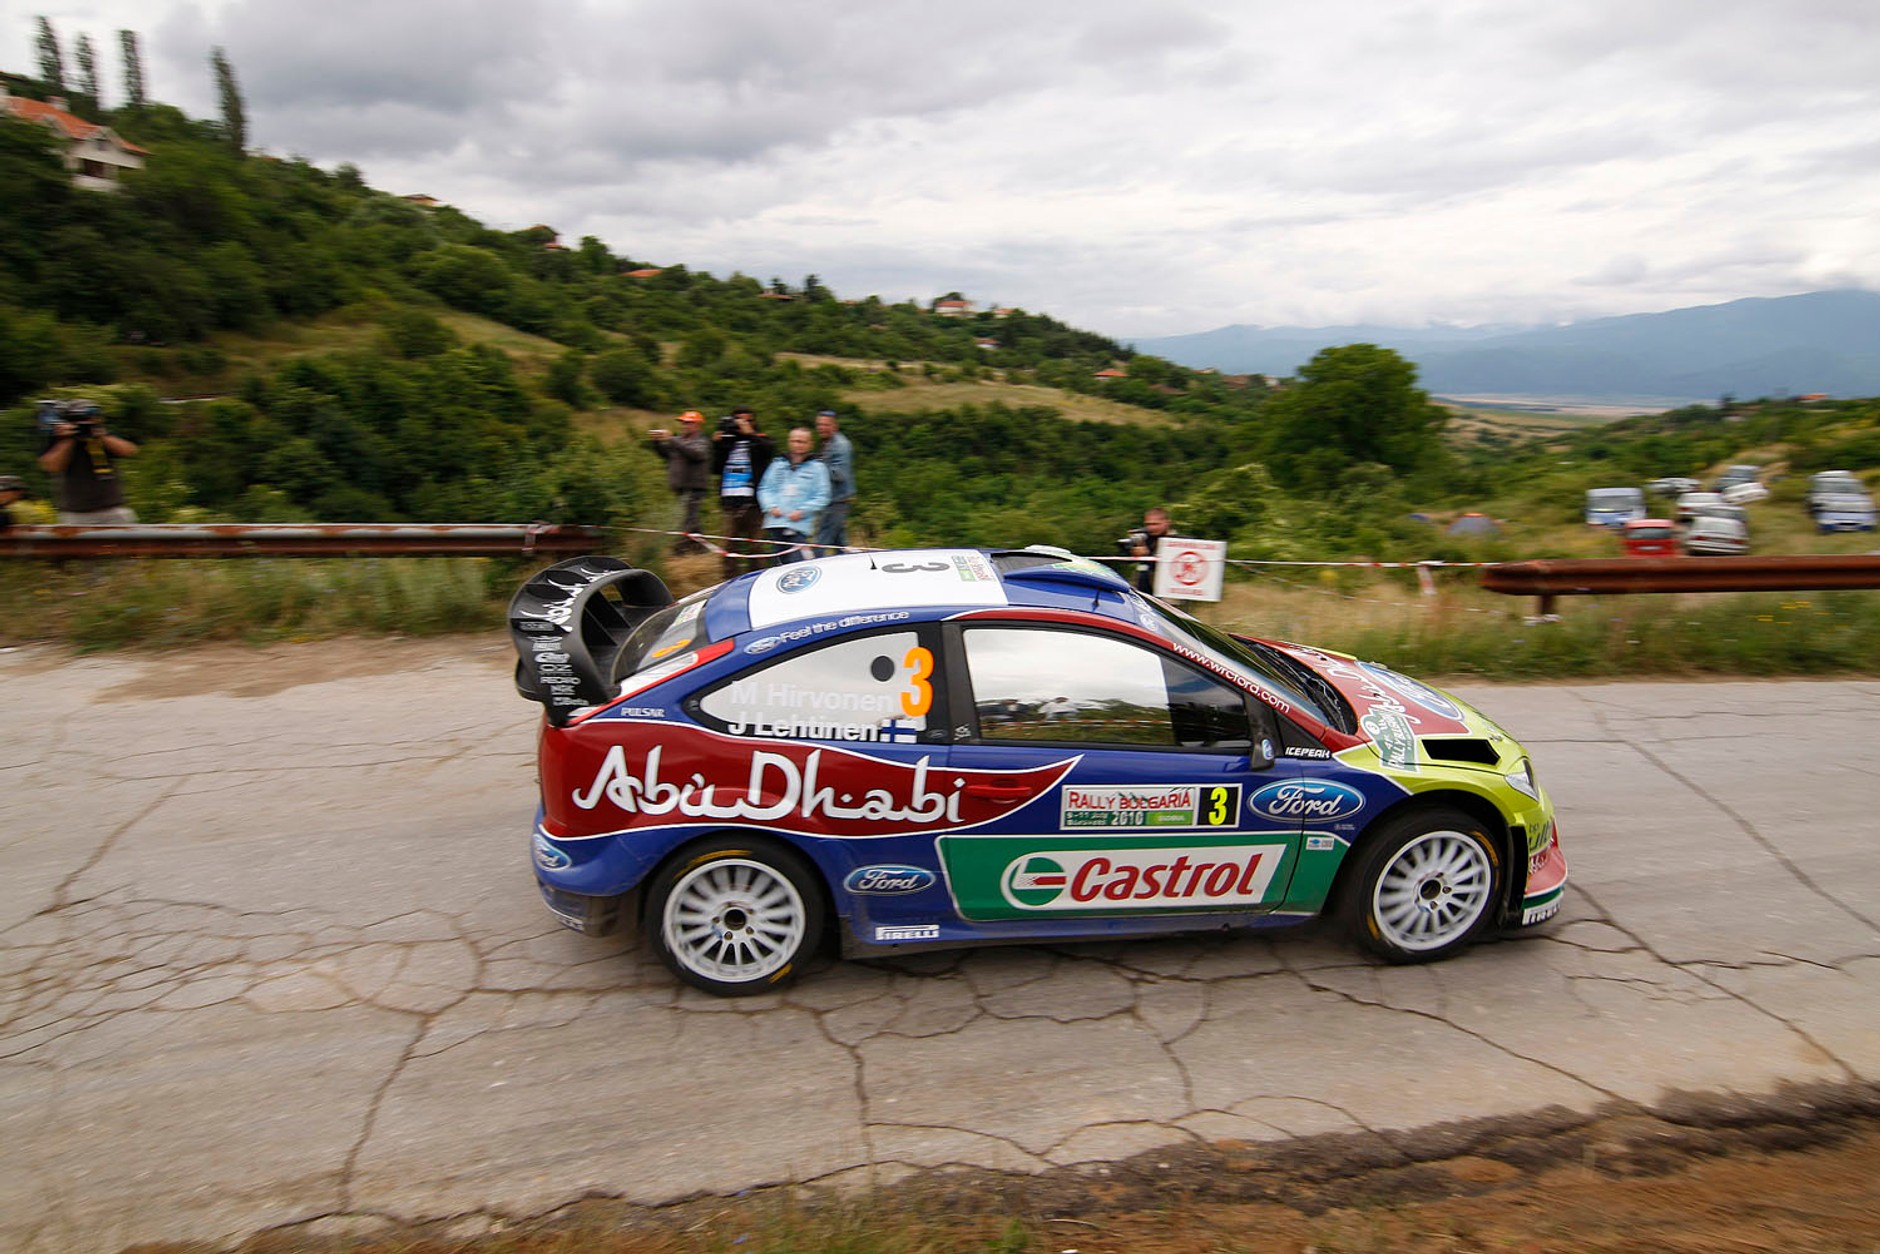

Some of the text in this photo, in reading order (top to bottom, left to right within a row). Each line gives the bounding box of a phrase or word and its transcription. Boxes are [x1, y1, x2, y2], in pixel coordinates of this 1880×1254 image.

[780, 611, 910, 643] Feel the difference
[901, 647, 934, 717] 3
[1173, 643, 1290, 713] www.wrcford.com
[732, 681, 894, 713] M Hirvonen
[728, 711, 879, 742] J Lehtinen
[1285, 746, 1330, 759] ICEPEAK
[1068, 791, 1116, 810] RALLY
[1208, 786, 1228, 826] 3
[1268, 785, 1344, 816] Ford
[1111, 811, 1145, 826] 2010
[858, 869, 920, 890] Ford
[1071, 852, 1264, 902] Castrol
[875, 924, 940, 940] PIRELLI
